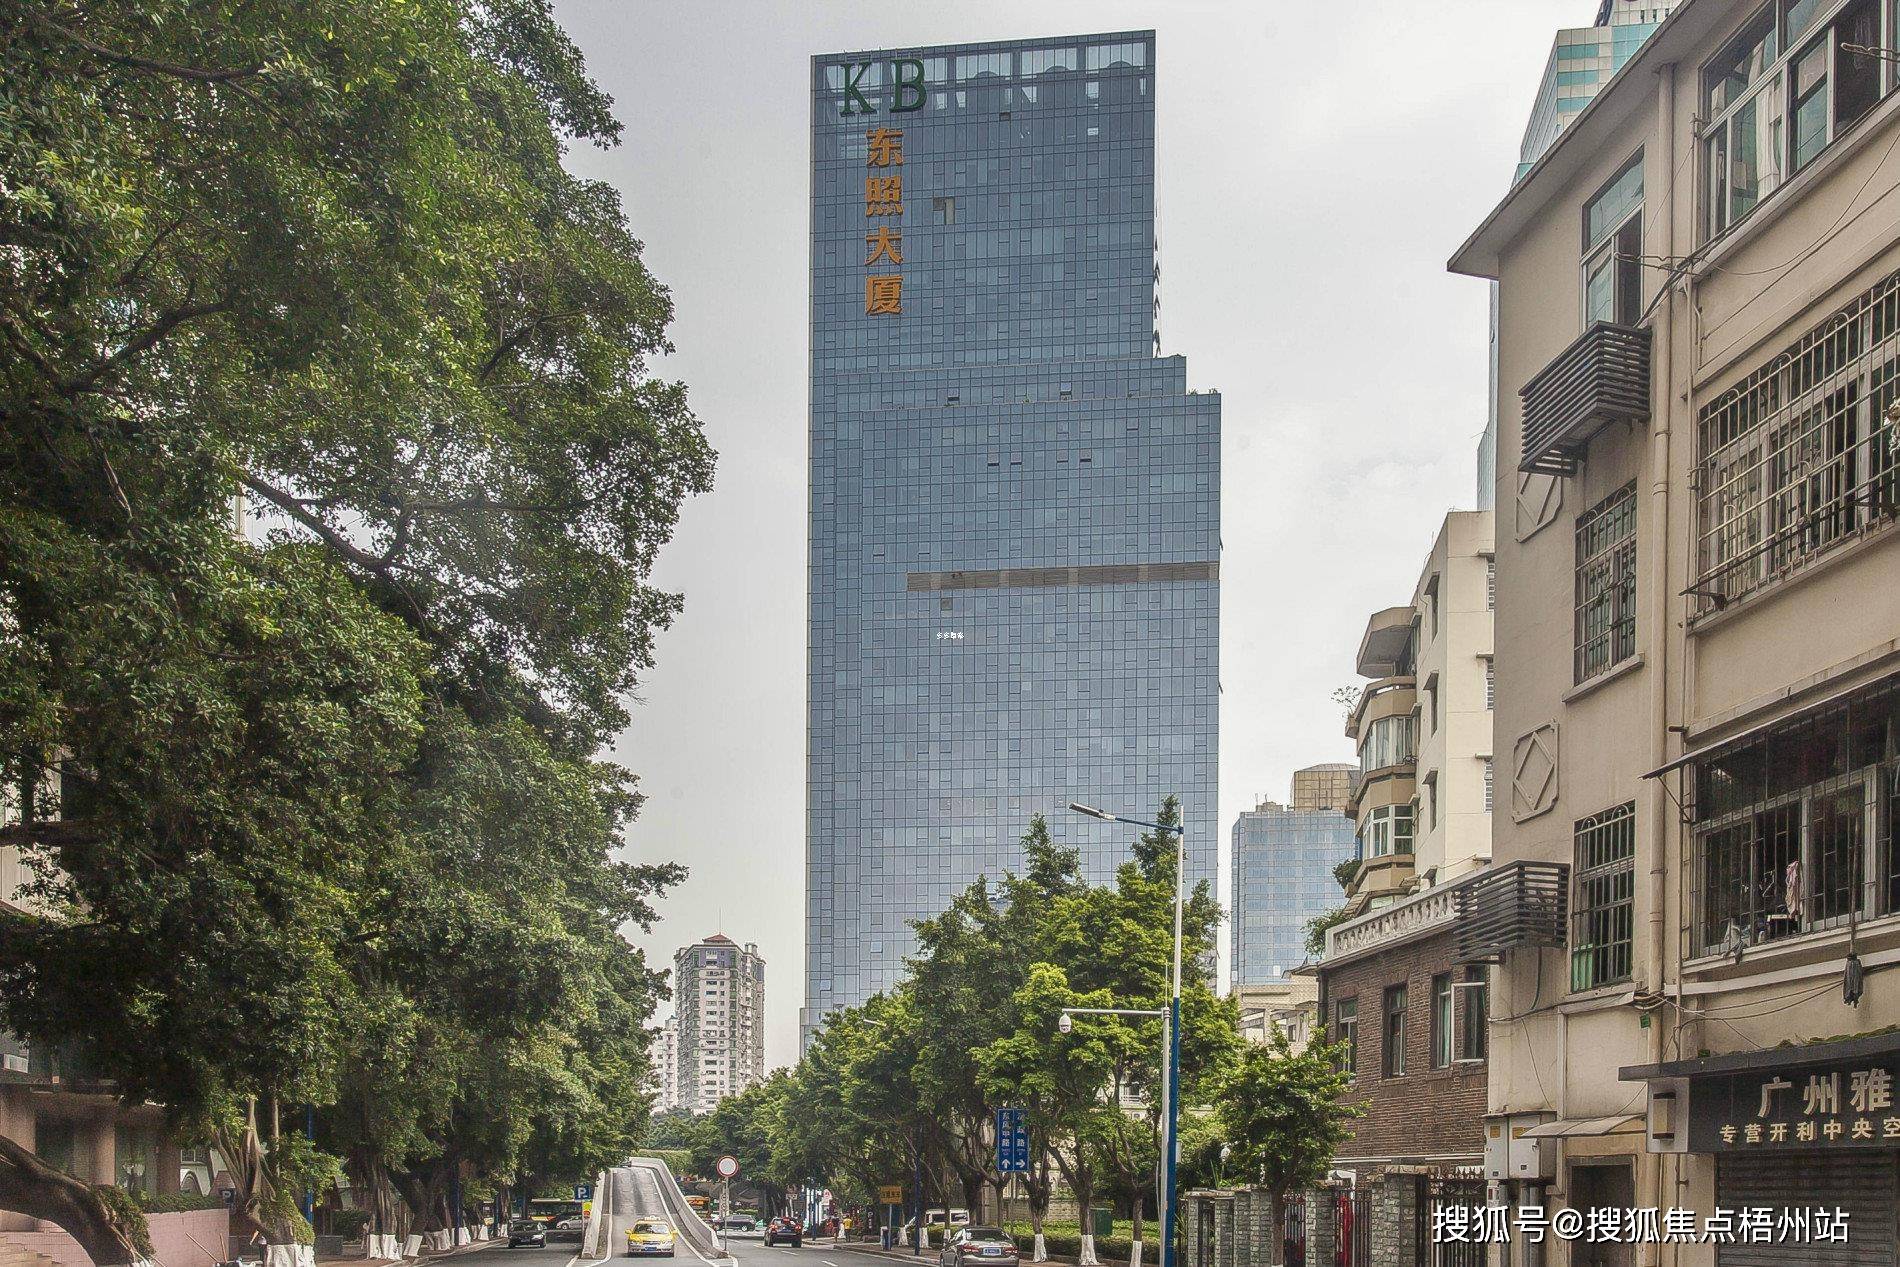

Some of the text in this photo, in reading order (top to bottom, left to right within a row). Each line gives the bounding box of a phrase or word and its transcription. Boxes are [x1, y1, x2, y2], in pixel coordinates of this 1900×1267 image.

[865, 127, 904, 316] 东照大厦
[1758, 1068, 1891, 1117] 广州雅
